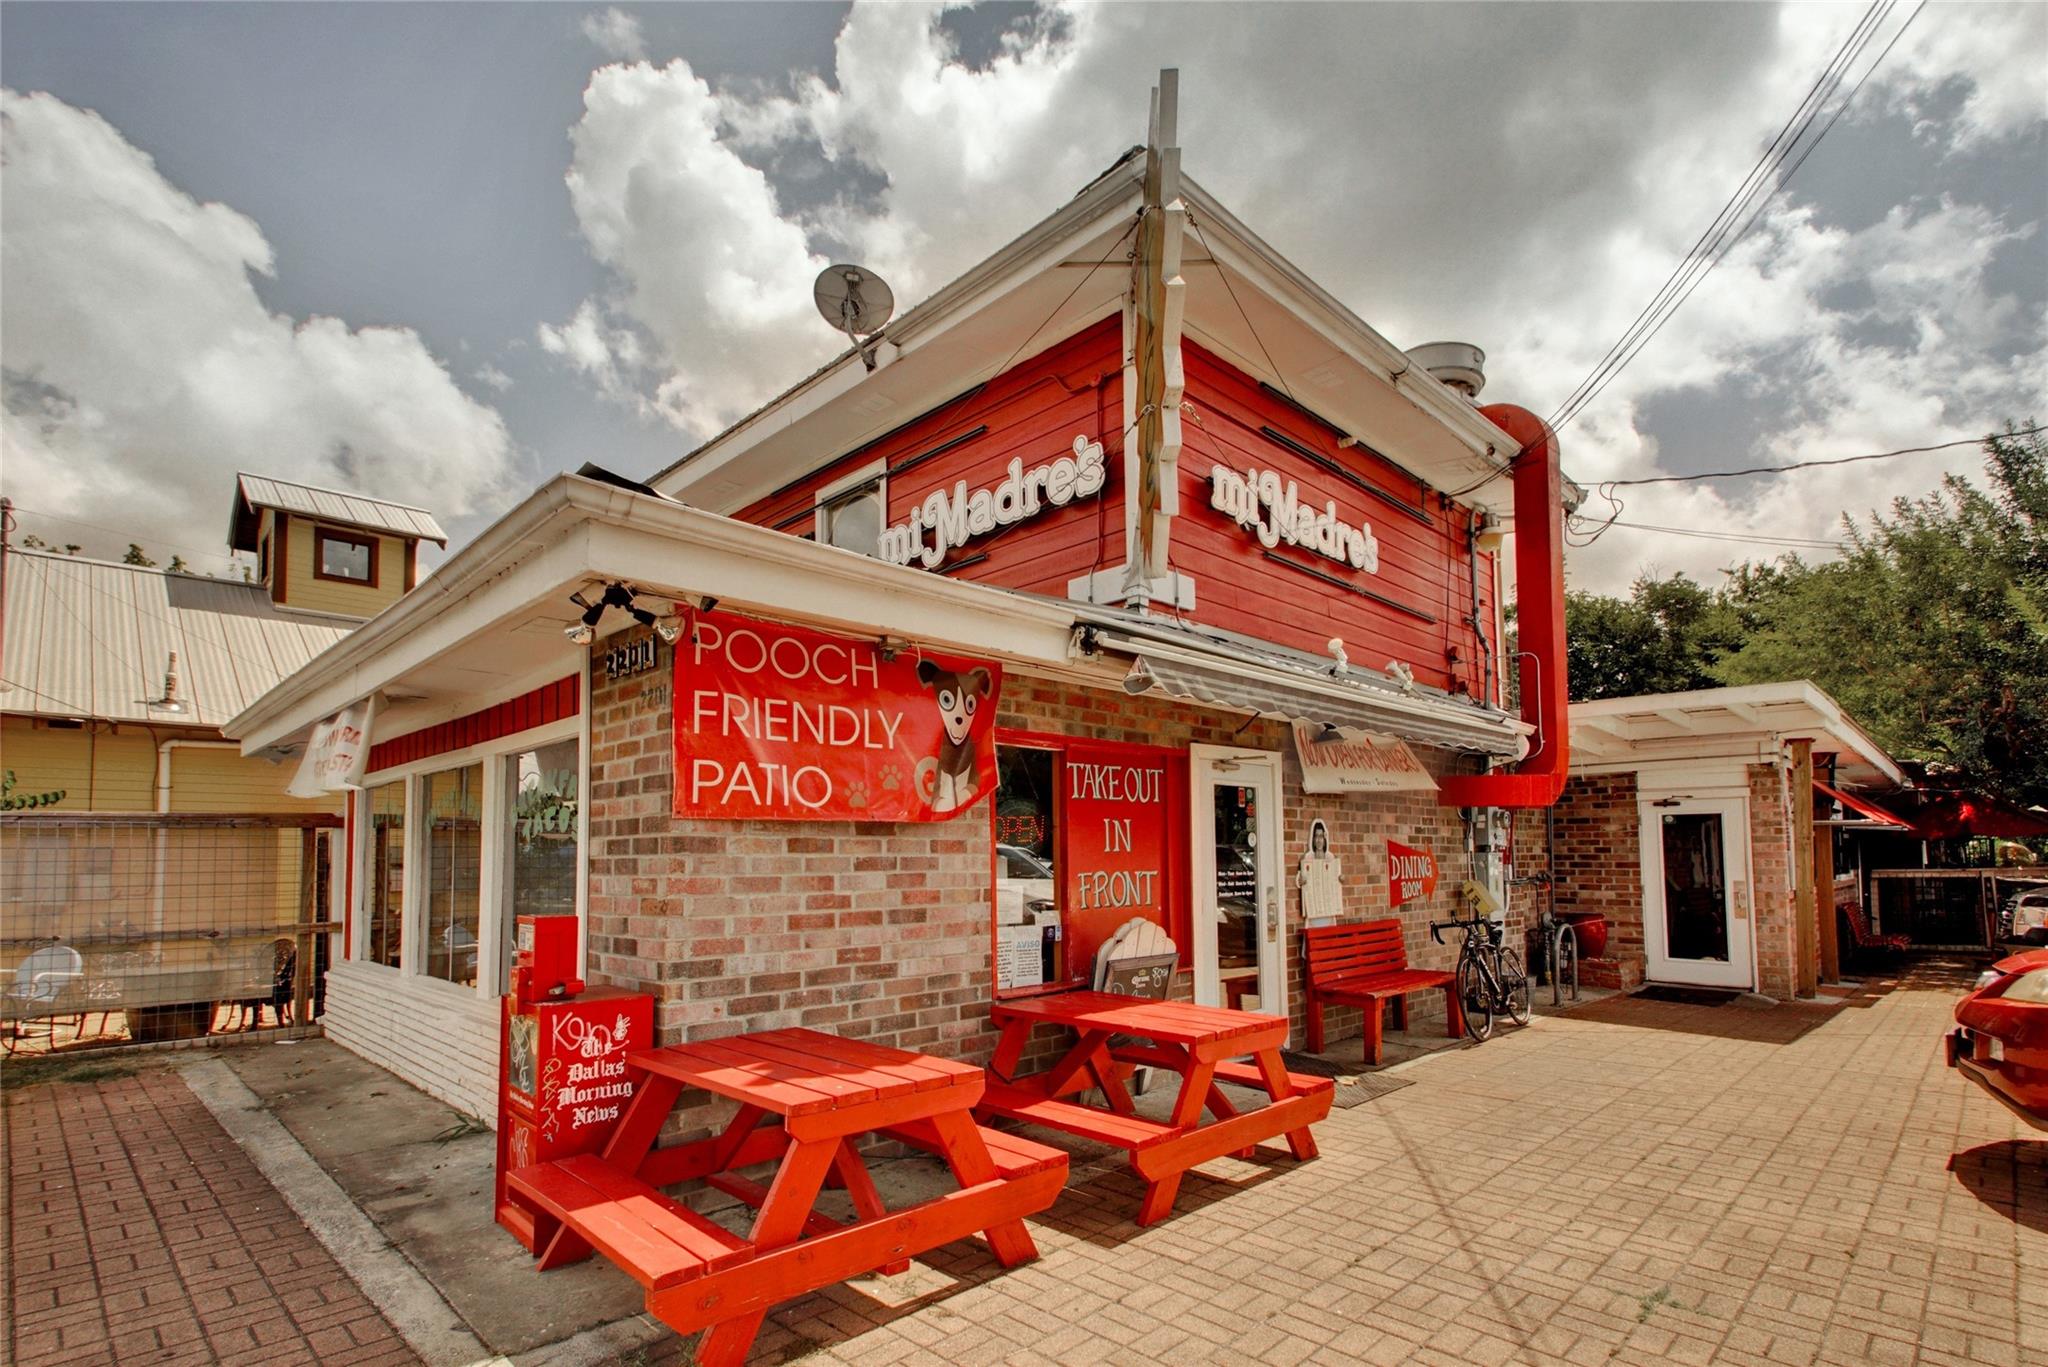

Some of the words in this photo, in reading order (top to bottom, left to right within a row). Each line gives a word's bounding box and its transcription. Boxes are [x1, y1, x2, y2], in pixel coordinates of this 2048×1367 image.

[878, 506, 924, 566] mi
[921, 434, 1106, 569] Madre's
[1211, 464, 1261, 526] mi
[1257, 470, 1379, 575] Madre's
[606, 637, 654, 676] 2201
[693, 621, 879, 689] POOCH
[693, 689, 904, 750] FRIENDLY
[692, 759, 833, 808] PATIO
[1066, 761, 1123, 800] TAKE
[1124, 767, 1164, 803] OUT
[1103, 818, 1131, 852] IN
[1390, 855, 1433, 880] DINING
[1077, 870, 1158, 909] FRONT
[1401, 880, 1423, 899] ROOM
[581, 1035, 613, 1059] The
[567, 1056, 625, 1086] Dallas
[556, 1081, 633, 1111] Morning
[572, 1103, 619, 1129] News
